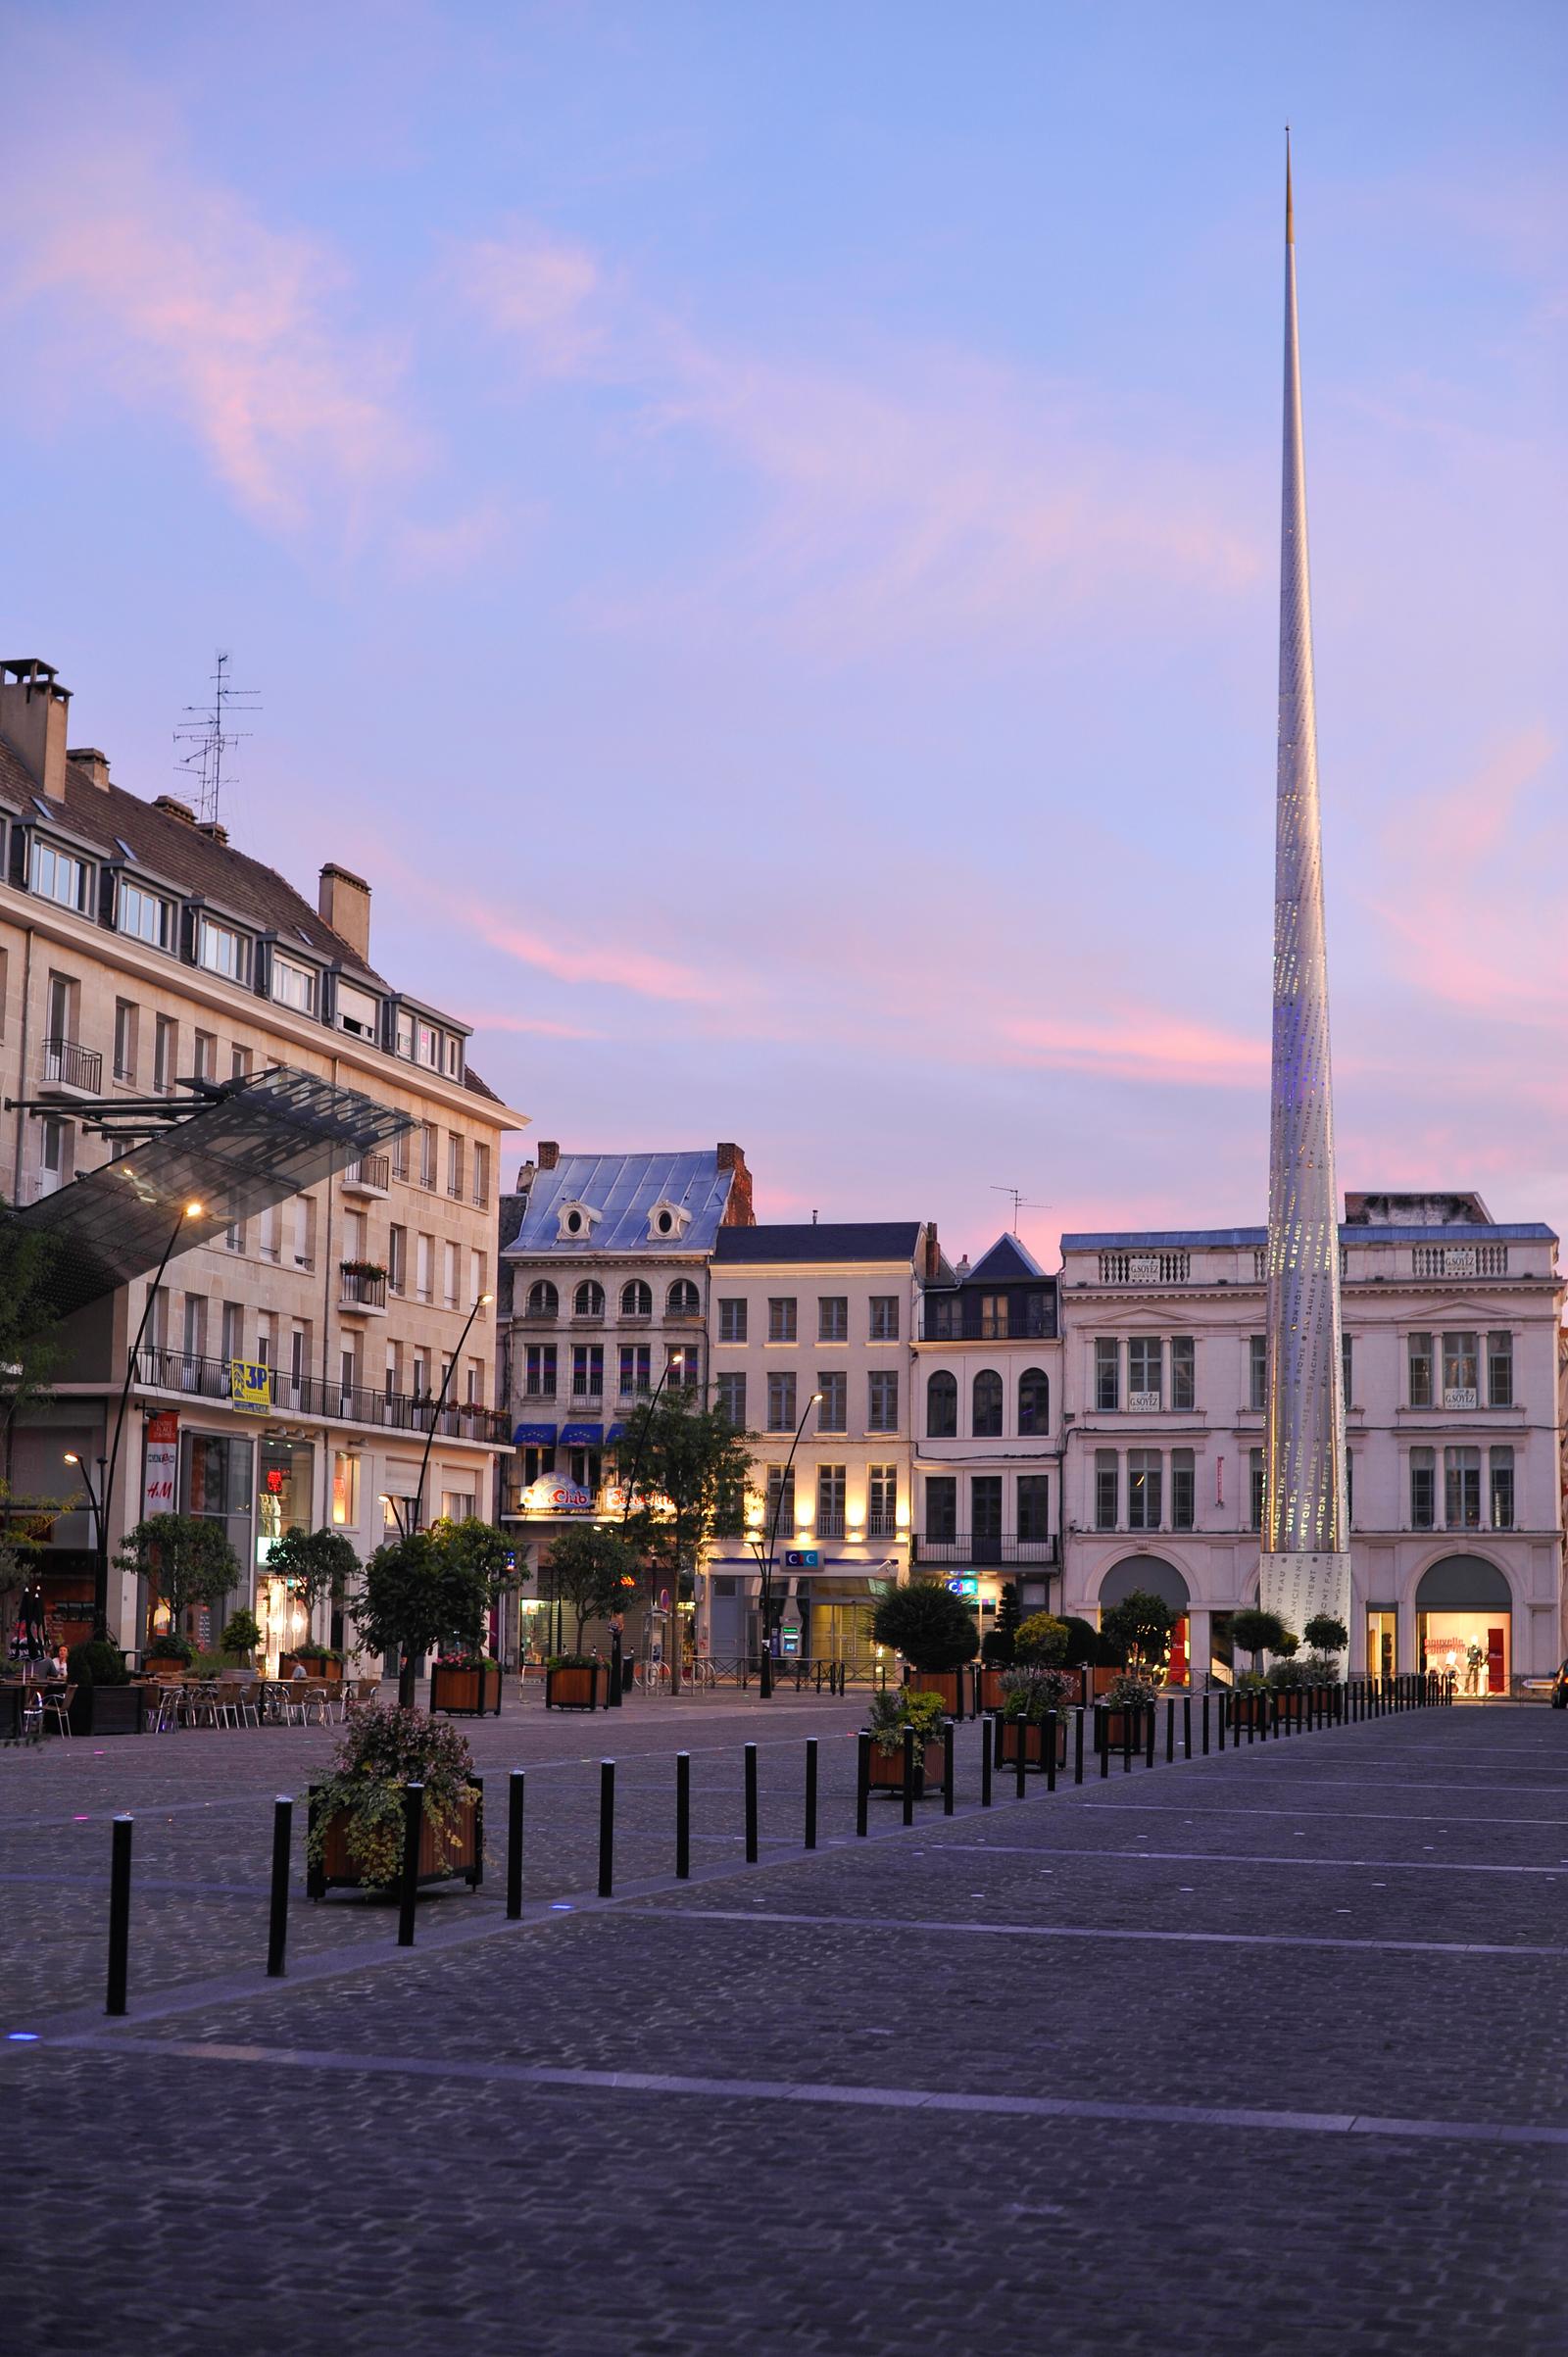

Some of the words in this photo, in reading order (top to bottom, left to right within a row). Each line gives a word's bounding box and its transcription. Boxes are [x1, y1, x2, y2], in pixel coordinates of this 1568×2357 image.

[245, 1364, 268, 1390] 3P
[1316, 1496, 1326, 1518] TON
[788, 1553, 815, 1565] CIC
[949, 1582, 977, 1593] CIC
